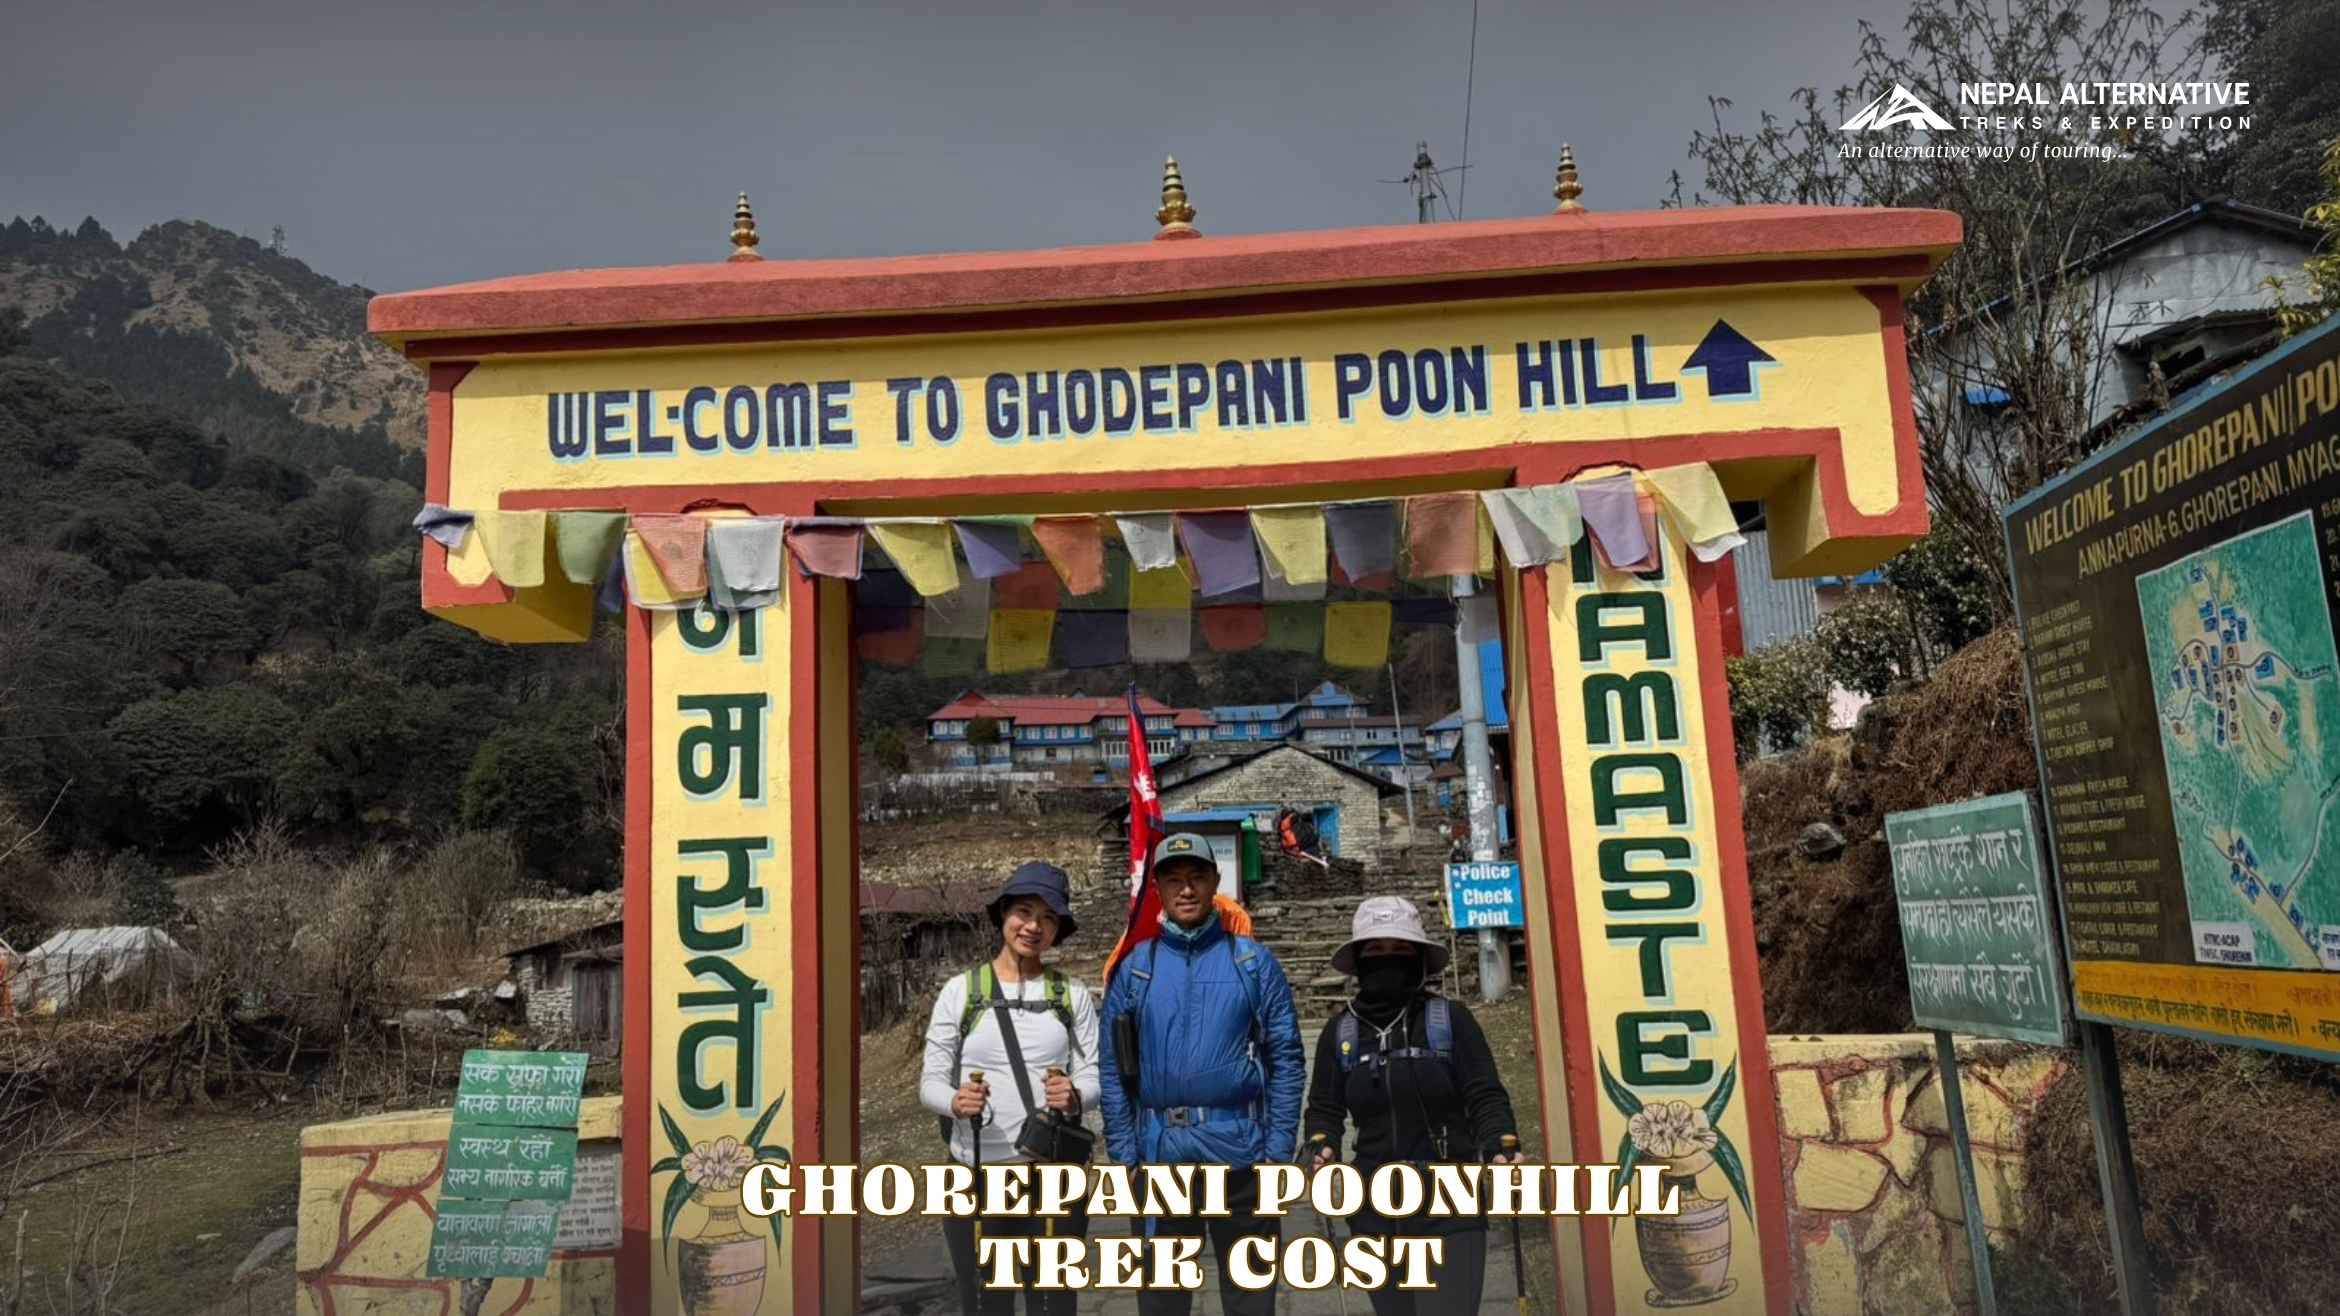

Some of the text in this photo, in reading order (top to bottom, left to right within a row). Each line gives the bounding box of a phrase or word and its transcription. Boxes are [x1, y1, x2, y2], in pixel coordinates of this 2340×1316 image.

[887, 376, 959, 443] TO
[984, 357, 1306, 439] GHODEPANI
[1336, 344, 1488, 420] POON
[1515, 334, 1678, 409] HILL
[2025, 476, 2115, 556] WELCOME
[2119, 463, 2148, 510] TO
[1460, 864, 1511, 881] Police
[1463, 887, 1514, 906] Check
[1467, 909, 1511, 926] Point
